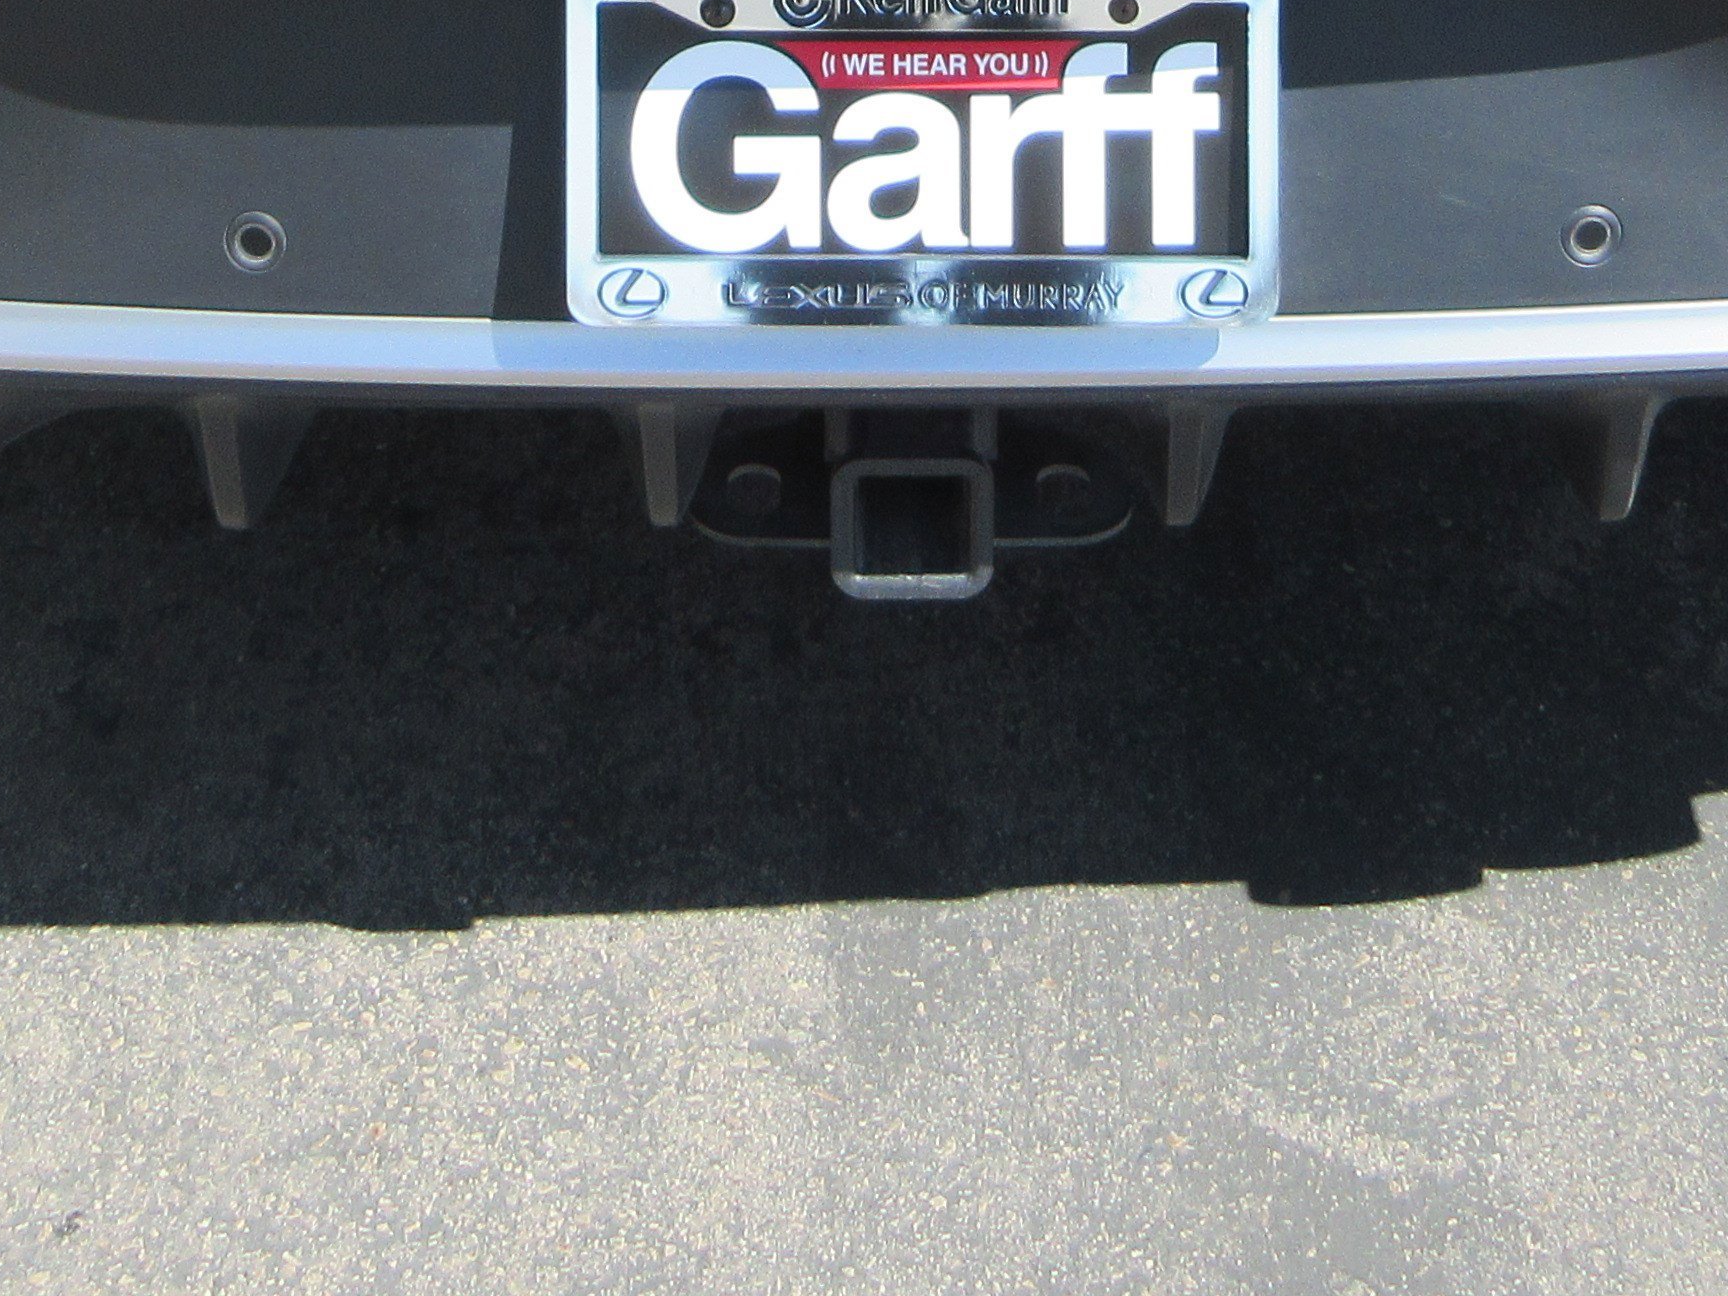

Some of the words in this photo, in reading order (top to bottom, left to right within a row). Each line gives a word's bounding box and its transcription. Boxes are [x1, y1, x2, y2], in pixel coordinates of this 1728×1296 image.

[841, 52, 886, 76] WE
[892, 52, 967, 76] HEAR
[973, 52, 1030, 76] YOU
[629, 39, 1221, 255] Garff
[721, 281, 913, 309] LEXUS
[917, 281, 972, 309] OF
[976, 281, 1125, 310] MURRAY
